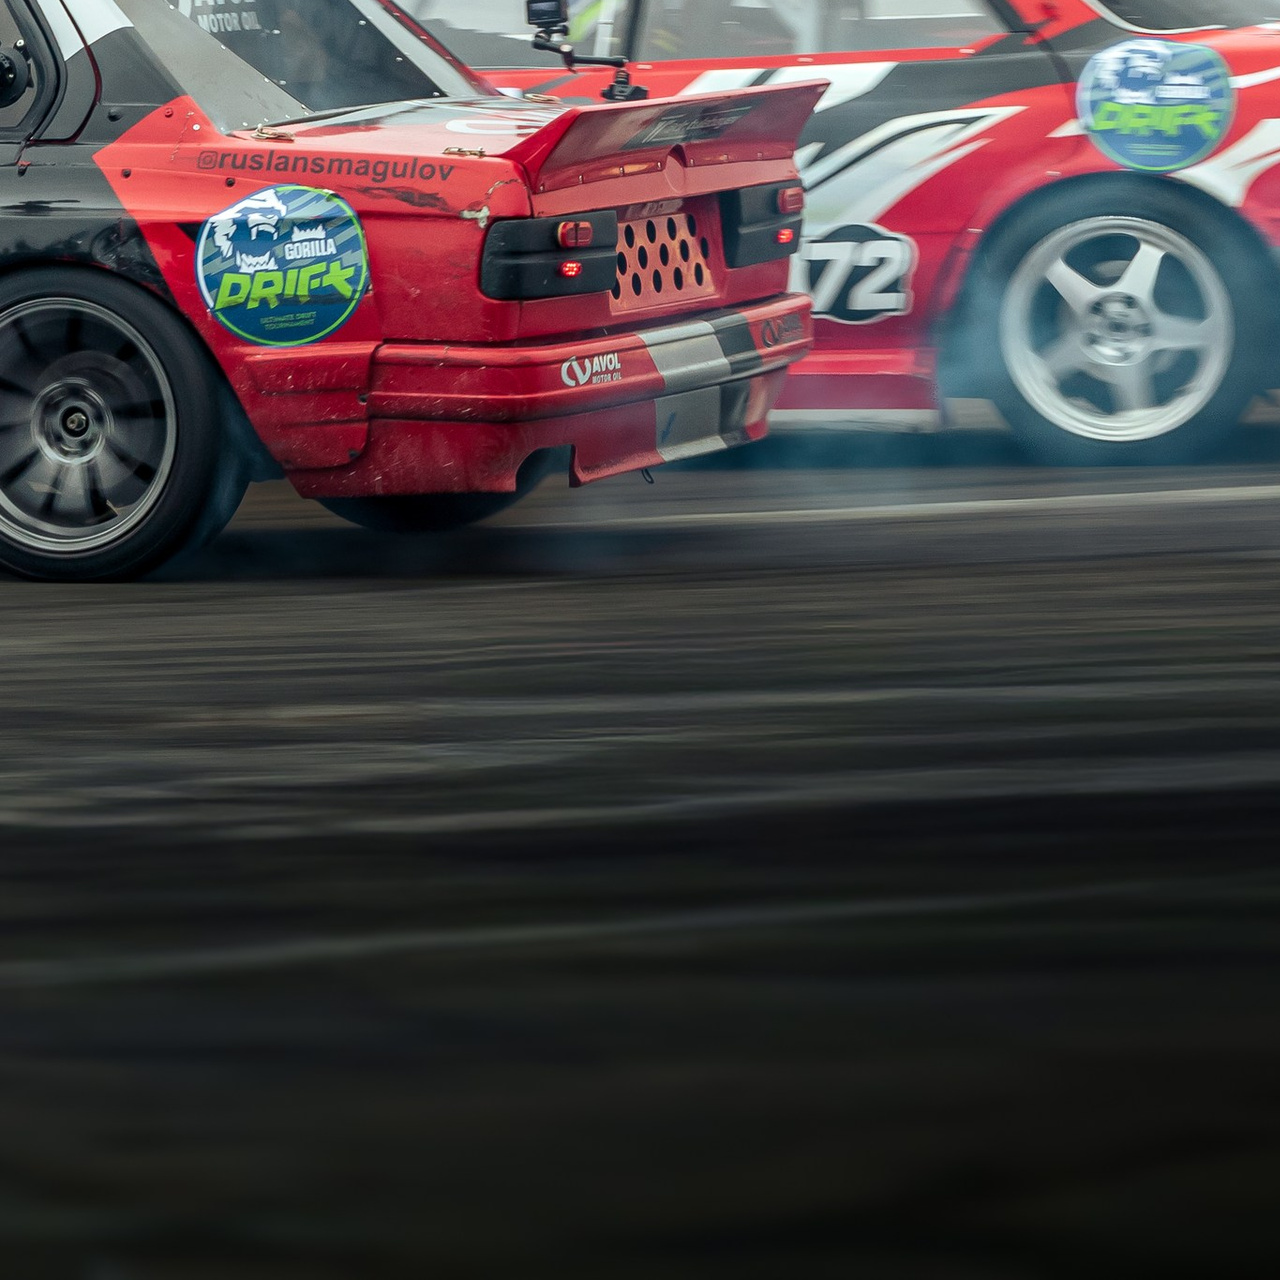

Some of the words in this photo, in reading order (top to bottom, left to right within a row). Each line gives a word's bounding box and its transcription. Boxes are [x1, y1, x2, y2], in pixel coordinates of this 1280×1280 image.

[197, 12, 241, 33] MOTOR
[283, 238, 338, 261] GORILLA
[802, 240, 911, 312] 72
[592, 352, 621, 374] AVOL
[592, 373, 612, 384] MOTOR
